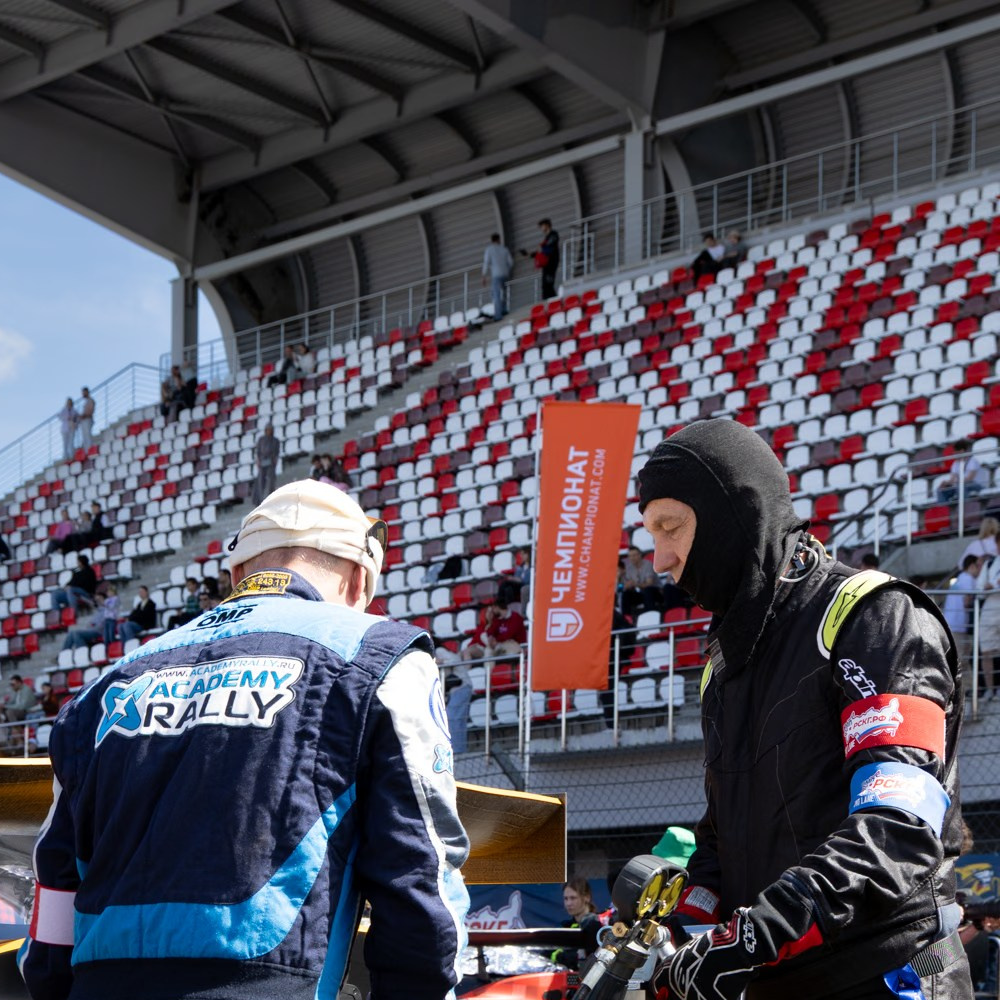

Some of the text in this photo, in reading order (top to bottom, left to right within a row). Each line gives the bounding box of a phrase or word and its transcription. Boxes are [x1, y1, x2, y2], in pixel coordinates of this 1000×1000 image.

[551, 446, 589, 603] ЧЕМПИОНАТ
[575, 448, 606, 603] WWW.CHAMPIONAT.COM
[197, 608, 253, 627] OMP
[149, 669, 292, 699] ACADEMY
[143, 690, 285, 729] RALLY
